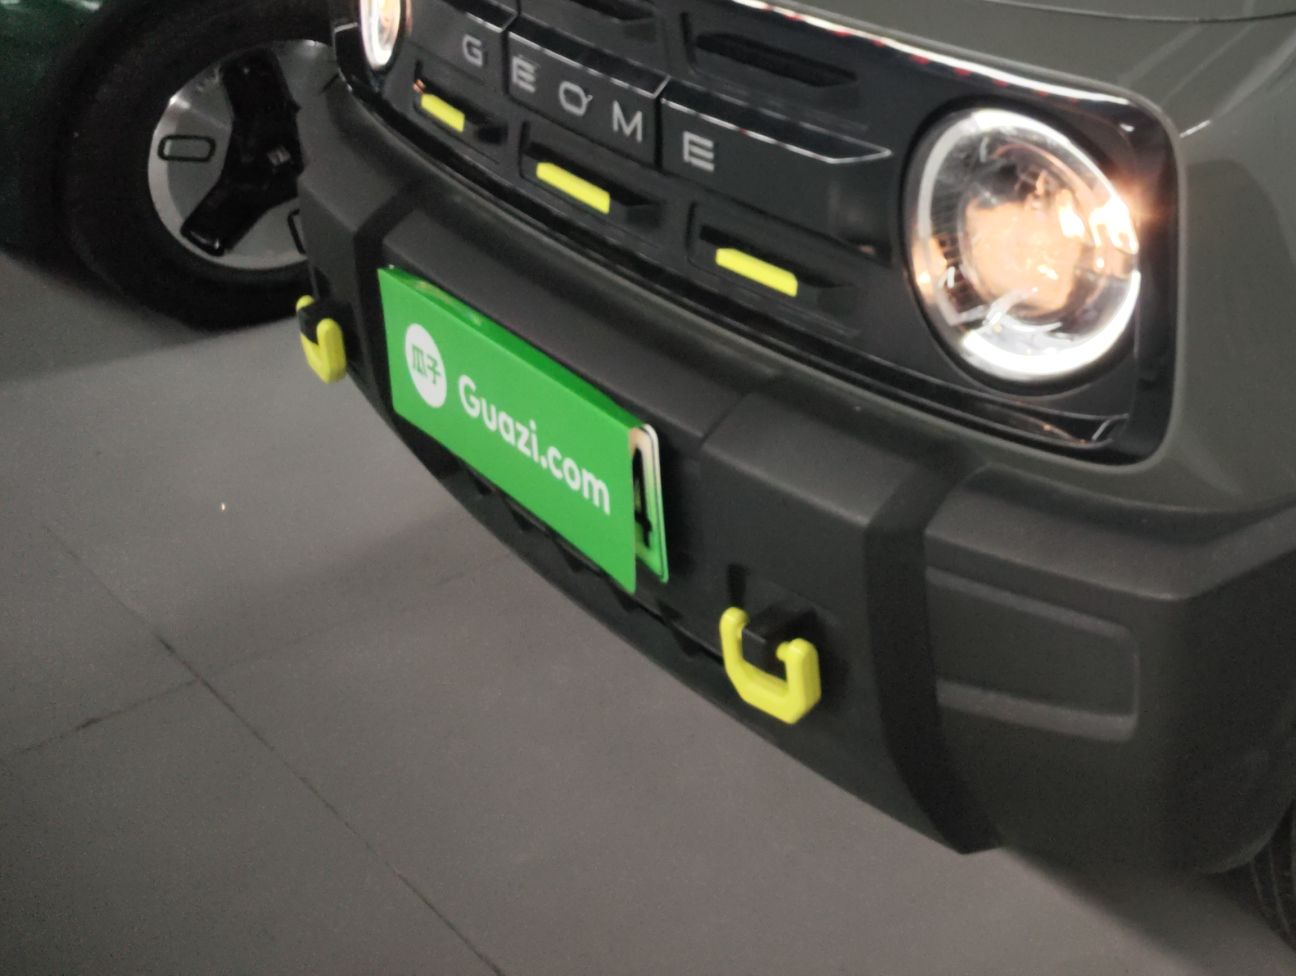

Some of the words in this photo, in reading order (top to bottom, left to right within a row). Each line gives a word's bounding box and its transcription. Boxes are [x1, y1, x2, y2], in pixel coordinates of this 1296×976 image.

[462, 34, 714, 172] GEOME
[411, 343, 442, 385] 瓜子
[458, 374, 611, 516] Guazi.com
